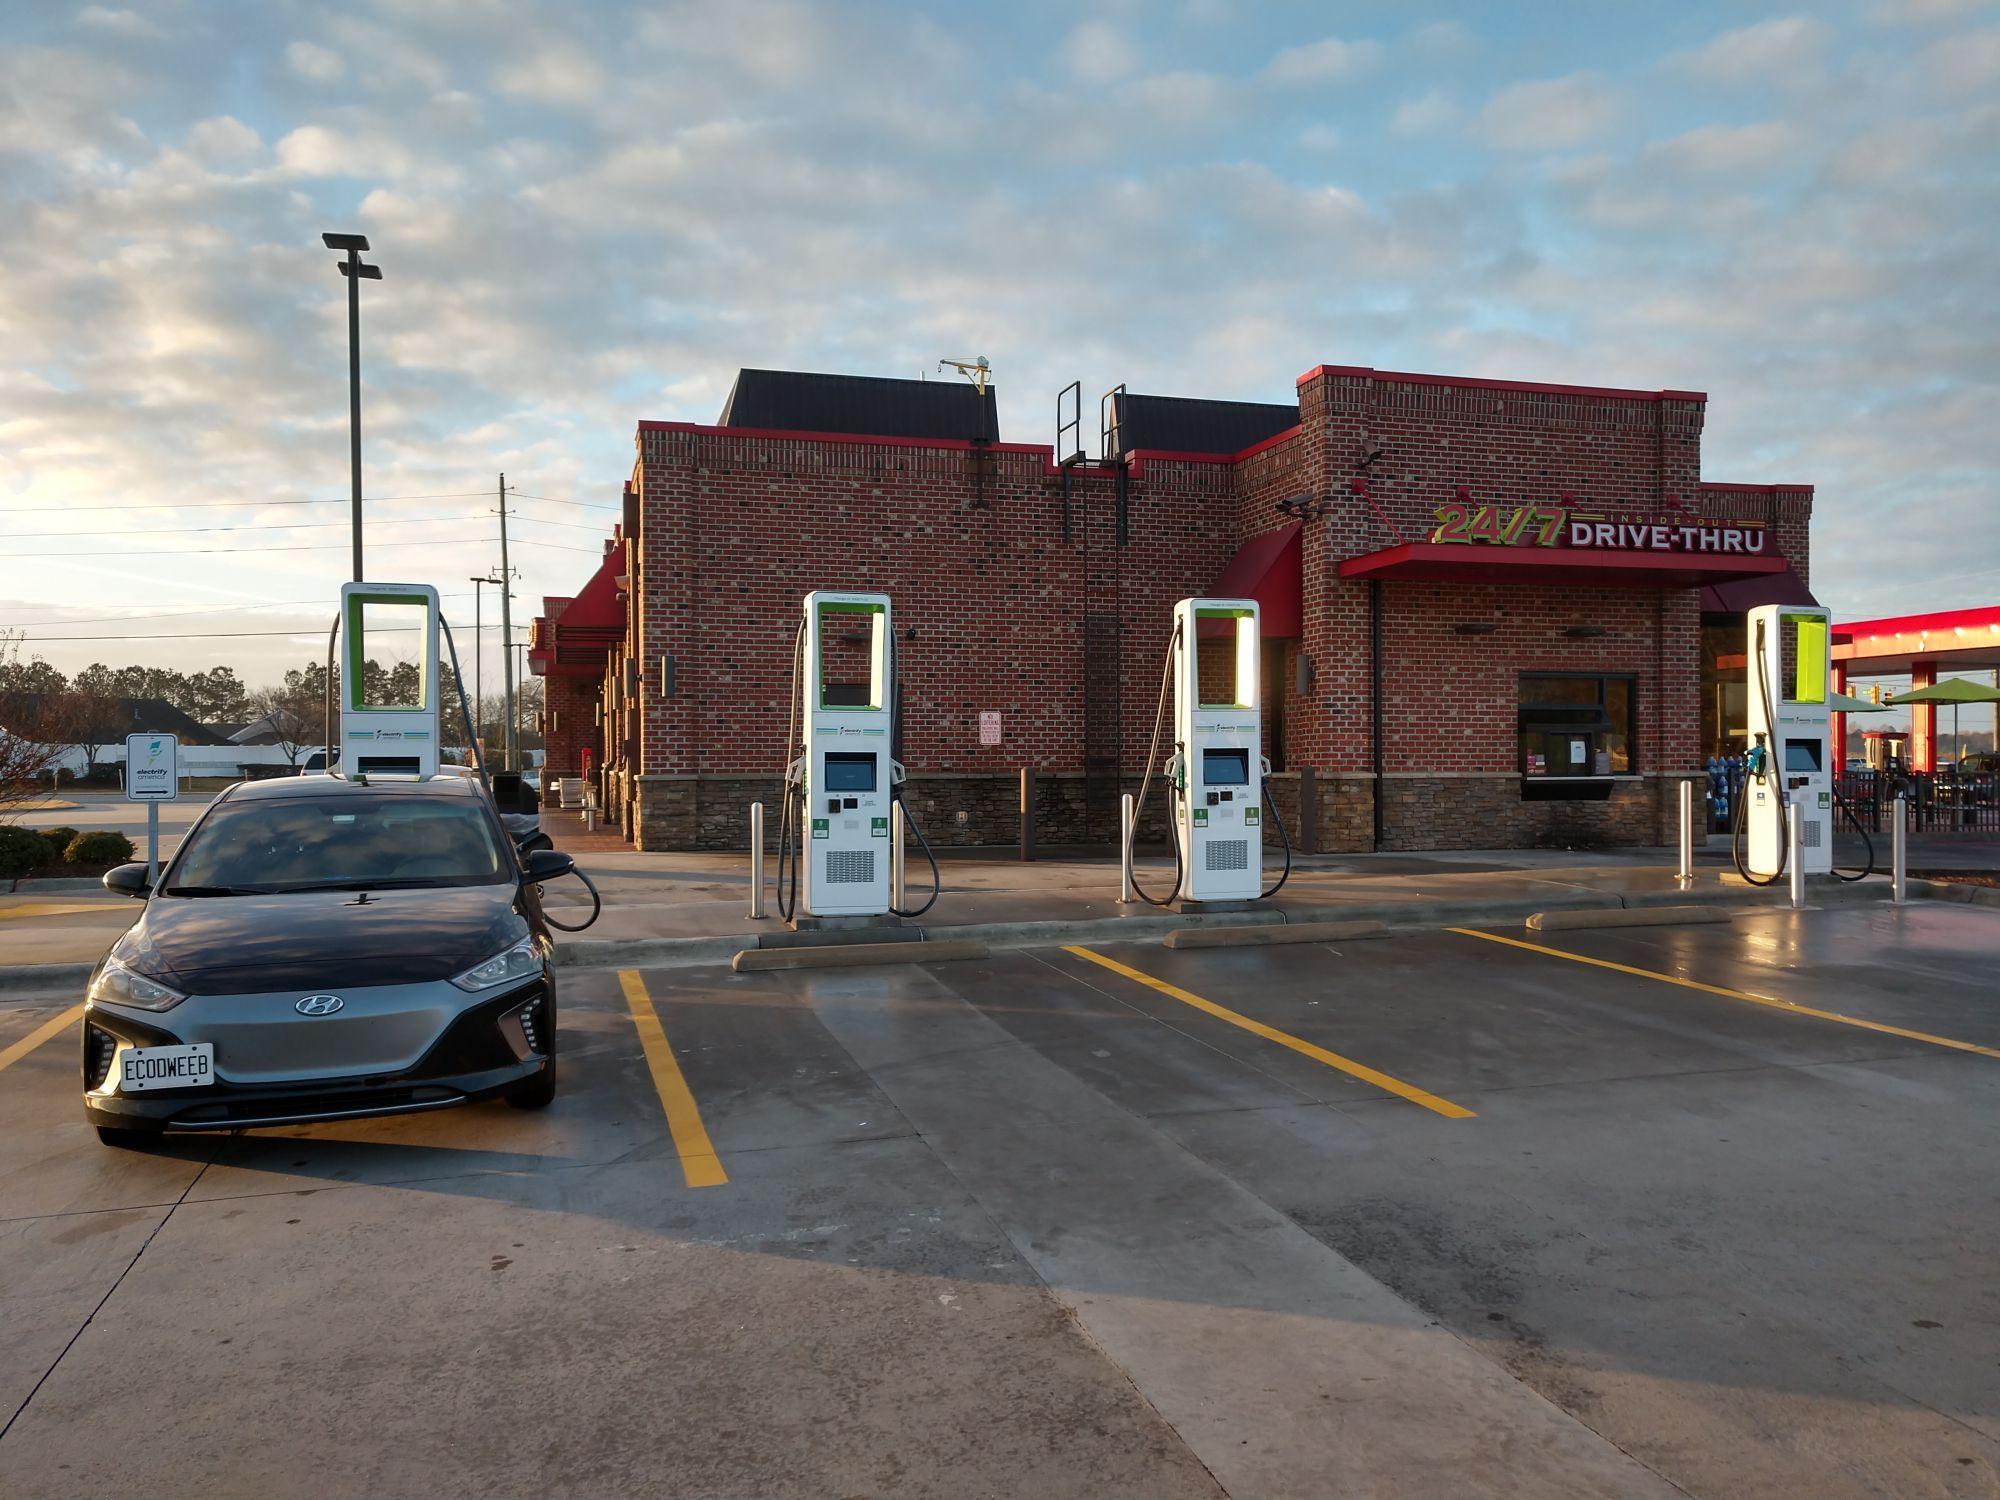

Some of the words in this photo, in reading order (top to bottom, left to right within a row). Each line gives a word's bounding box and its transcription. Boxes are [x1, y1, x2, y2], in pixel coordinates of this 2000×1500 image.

[1434, 504, 1567, 546] 24/7
[1571, 523, 1764, 552] DRIVE-THRU
[125, 1055, 208, 1081] ECODWEEB
